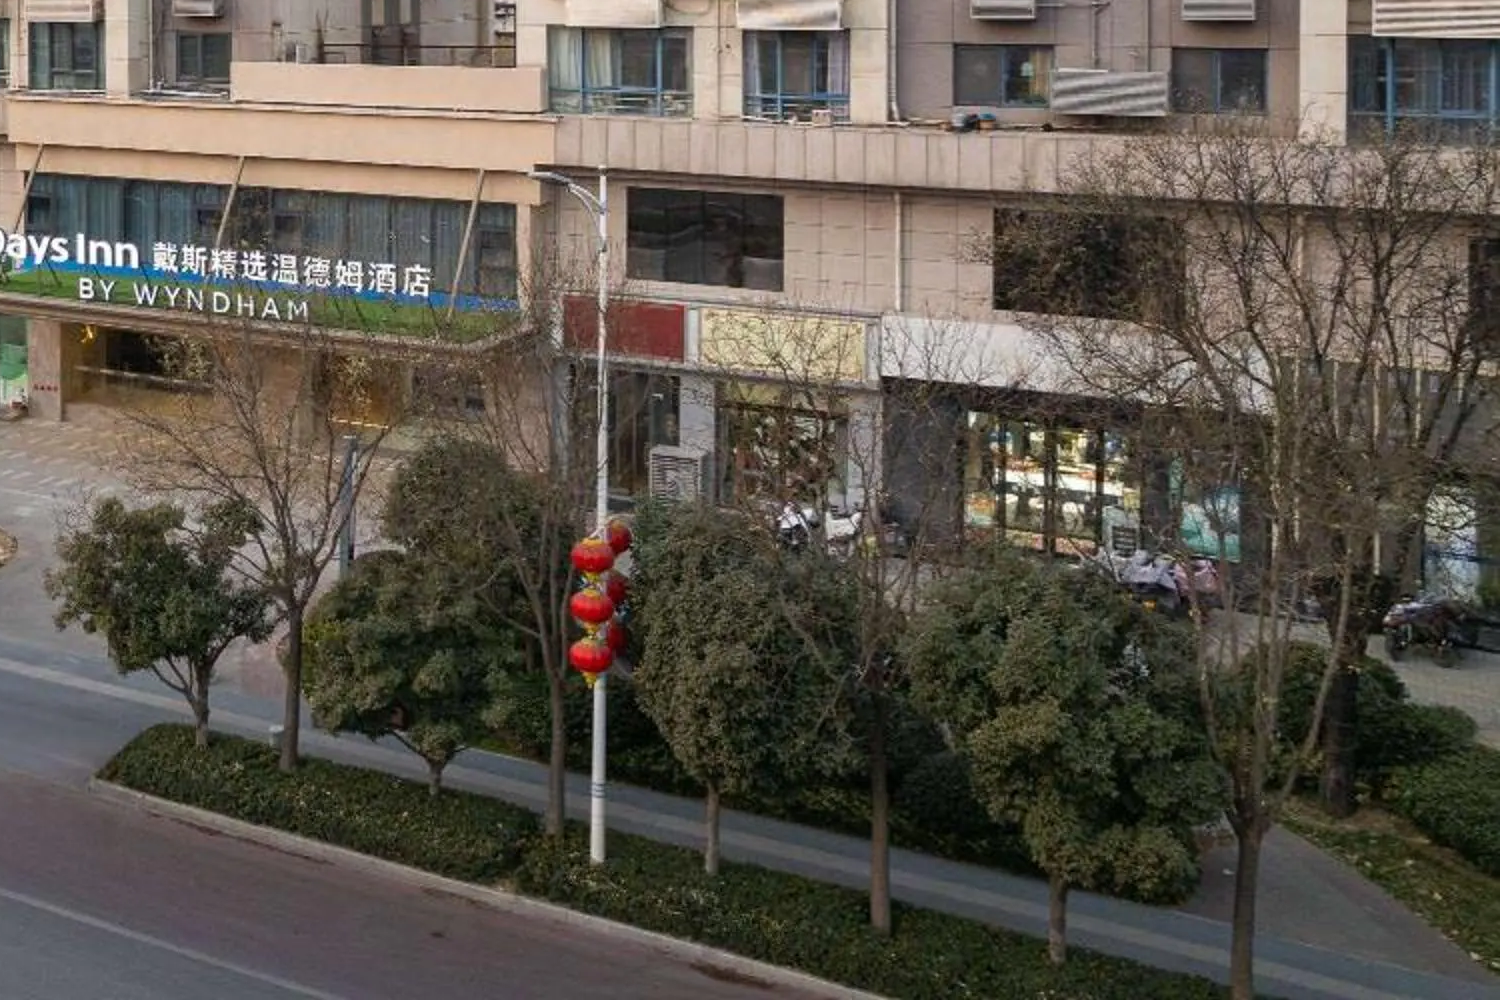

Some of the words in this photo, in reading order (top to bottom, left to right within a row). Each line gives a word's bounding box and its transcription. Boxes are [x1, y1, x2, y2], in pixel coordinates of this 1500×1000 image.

[76, 233, 139, 269] Inn
[152, 241, 431, 297] 戴斯精选温德姆酒店
[79, 277, 115, 301] BY
[133, 282, 309, 322] WYNDHAM
